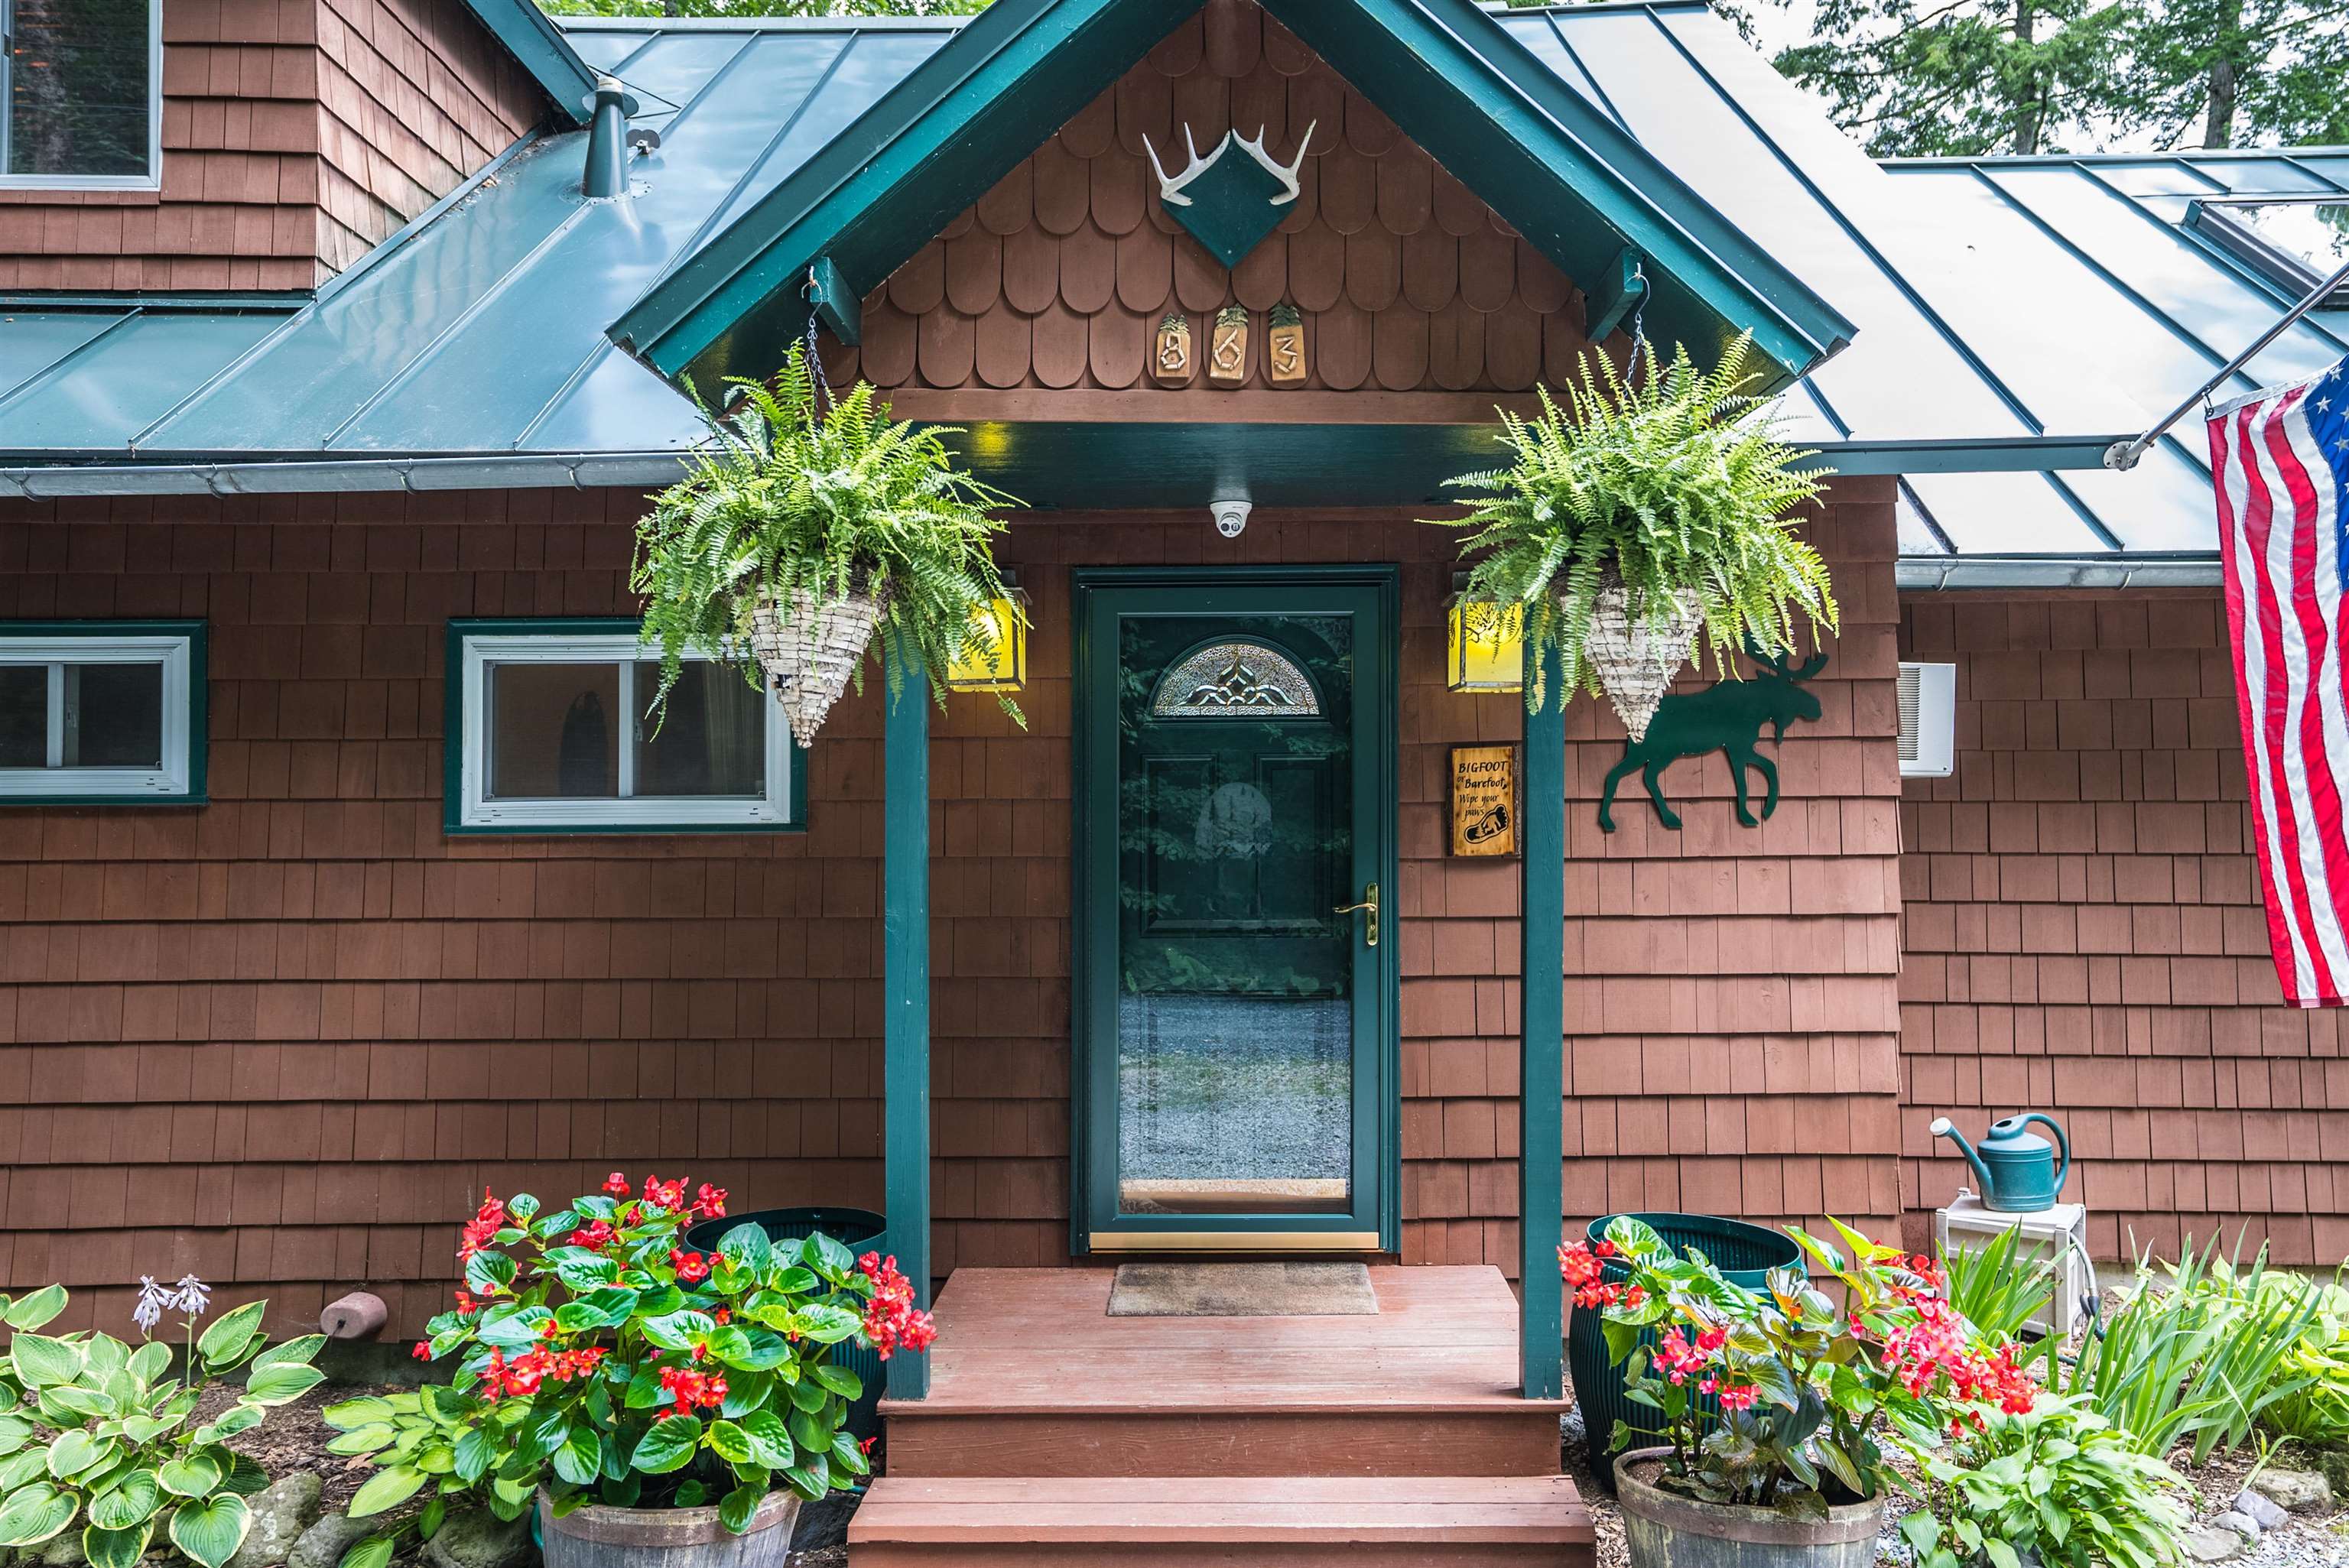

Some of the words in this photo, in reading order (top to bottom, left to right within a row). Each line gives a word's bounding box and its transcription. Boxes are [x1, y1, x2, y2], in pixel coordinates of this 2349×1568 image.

[1459, 761, 1508, 773] BIGFOOT
[1465, 777, 1507, 790] Barefoot,
[1459, 794, 1479, 808] Wipe
[1478, 794, 1499, 808] your
[1462, 809, 1485, 823] paws
